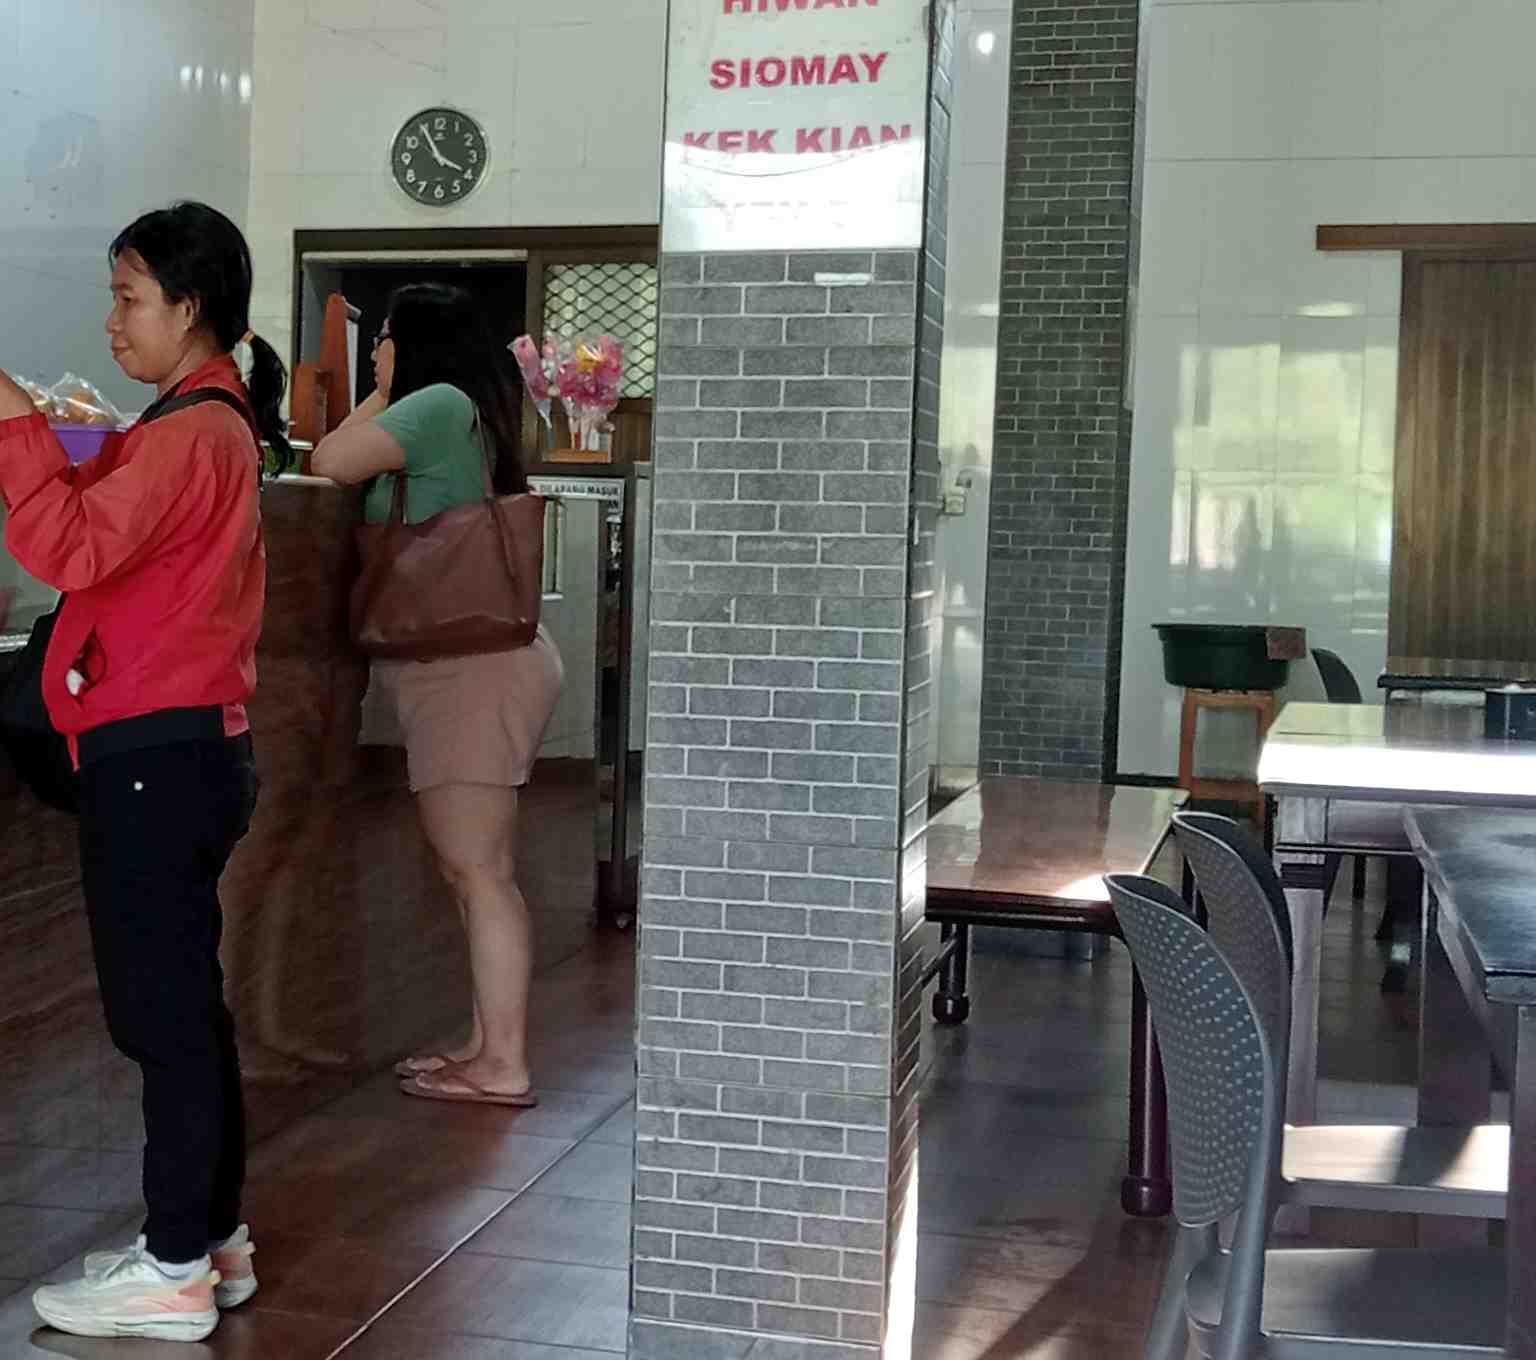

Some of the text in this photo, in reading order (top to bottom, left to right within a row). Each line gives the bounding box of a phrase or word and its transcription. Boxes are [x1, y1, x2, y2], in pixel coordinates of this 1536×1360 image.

[711, 52, 886, 90] SIOMAY
[434, 117, 446, 130] 12
[406, 135, 419, 149] 10
[464, 133, 473, 147] 2
[401, 152, 412, 165] 9
[468, 149, 478, 163] 3
[406, 169, 416, 183] 8
[463, 168, 473, 180] 4
[418, 181, 428, 195] 7
[434, 184, 445, 198] 6
[451, 180, 461, 193] 5
